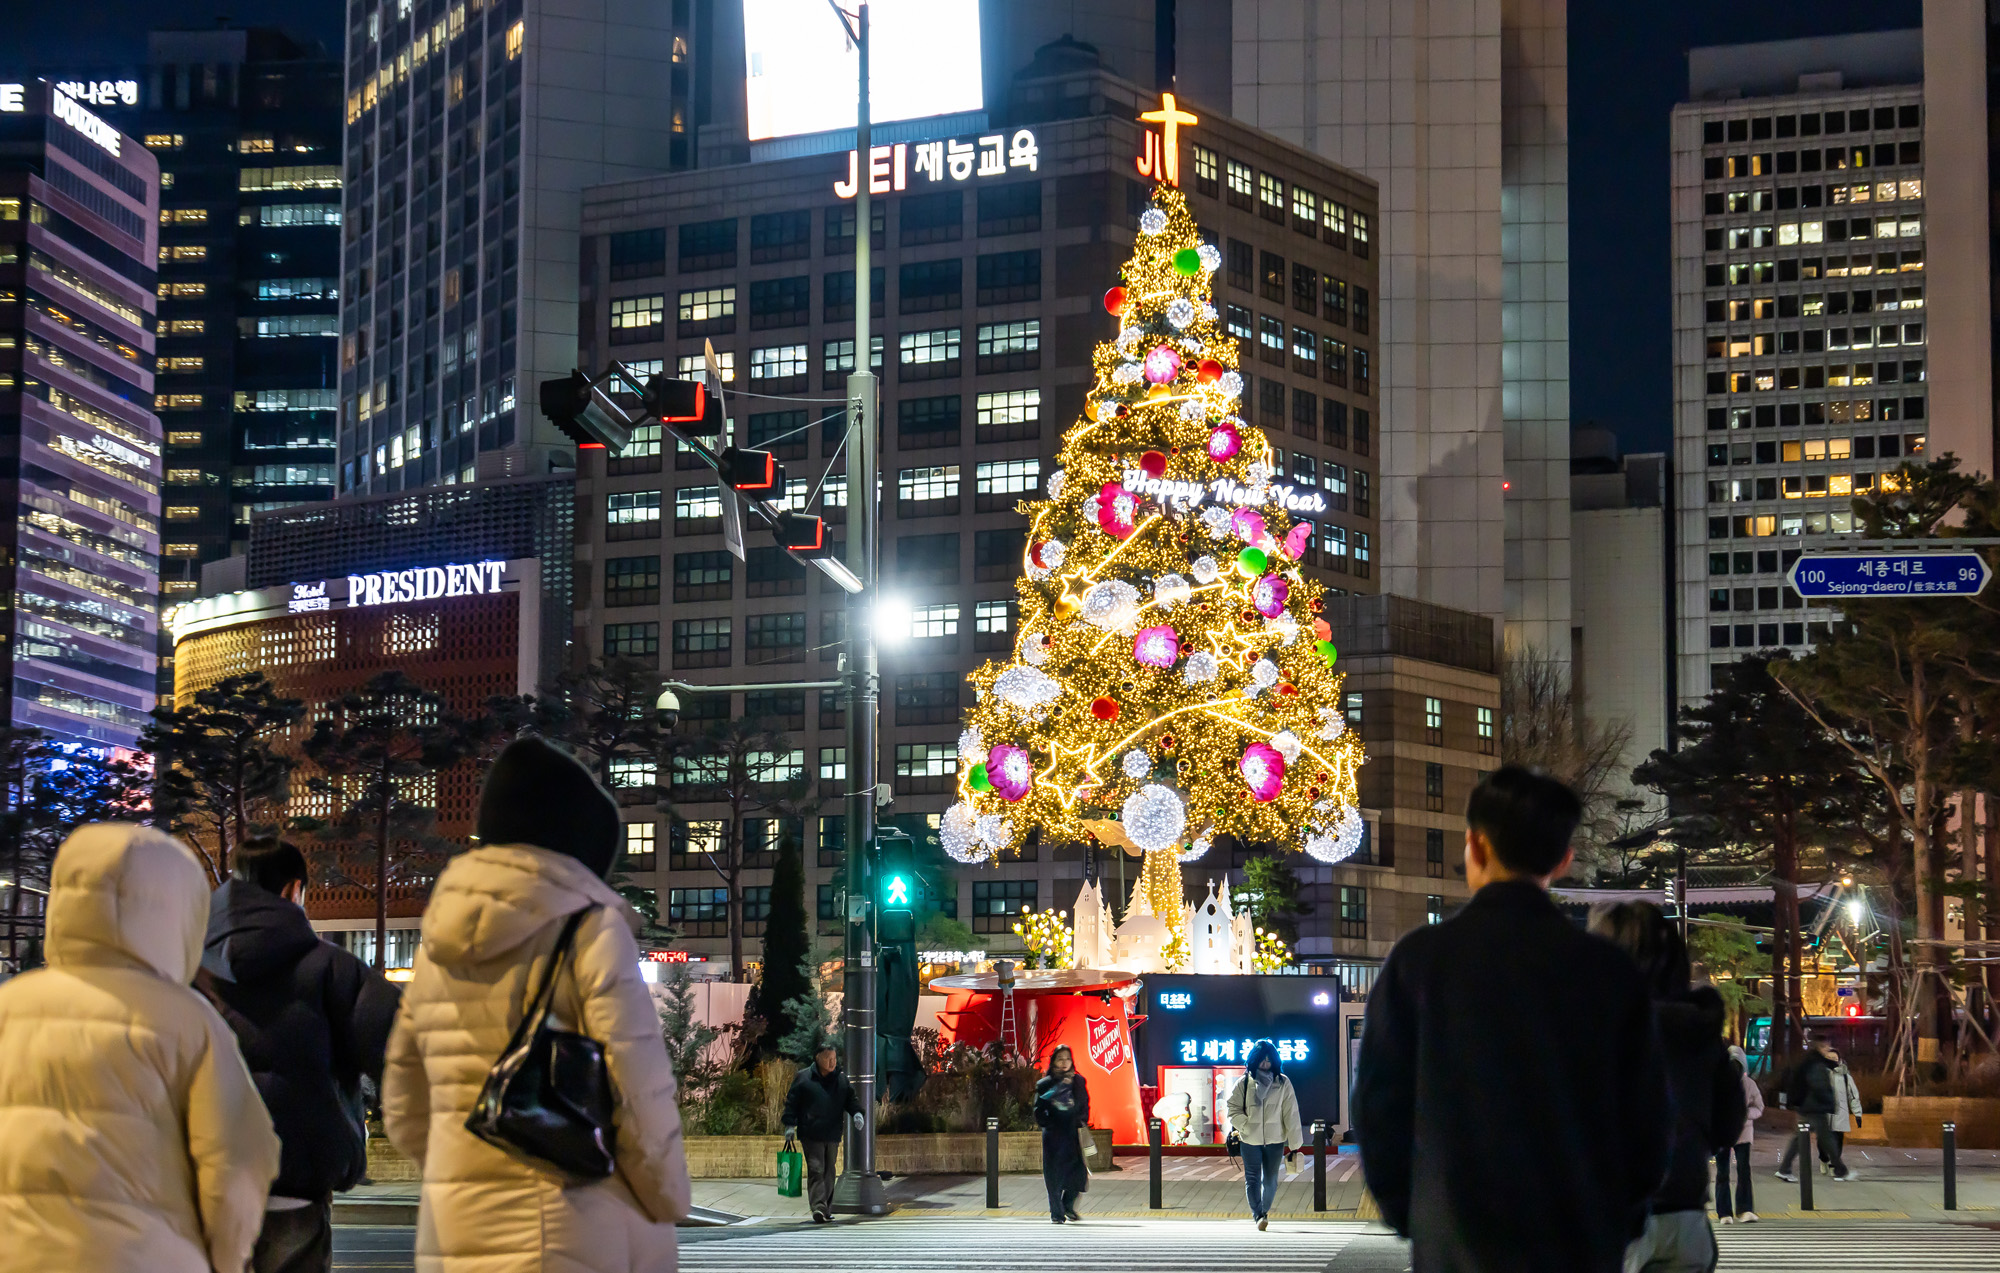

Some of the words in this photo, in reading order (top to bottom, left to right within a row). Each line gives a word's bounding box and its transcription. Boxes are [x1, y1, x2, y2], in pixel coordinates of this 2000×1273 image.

[53, 87, 121, 158] DOUZONE
[914, 129, 1039, 183] 재능교육
[1122, 469, 1205, 507] Happy
[1210, 478, 1268, 506] New
[1269, 484, 1327, 513] Year
[1800, 570, 1825, 584] 100
[1857, 560, 1926, 578] 세종대로
[1958, 567, 1978, 581] 96
[293, 581, 326, 600] Hotel
[346, 560, 507, 608] PRESIDENT
[1091, 1024, 1120, 1060] SALVATION
[1093, 1022, 1107, 1040] THE
[1104, 1041, 1120, 1067] ARMY
[1180, 1039, 1198, 1062] 전
[1202, 1039, 1236, 1062] 세계
